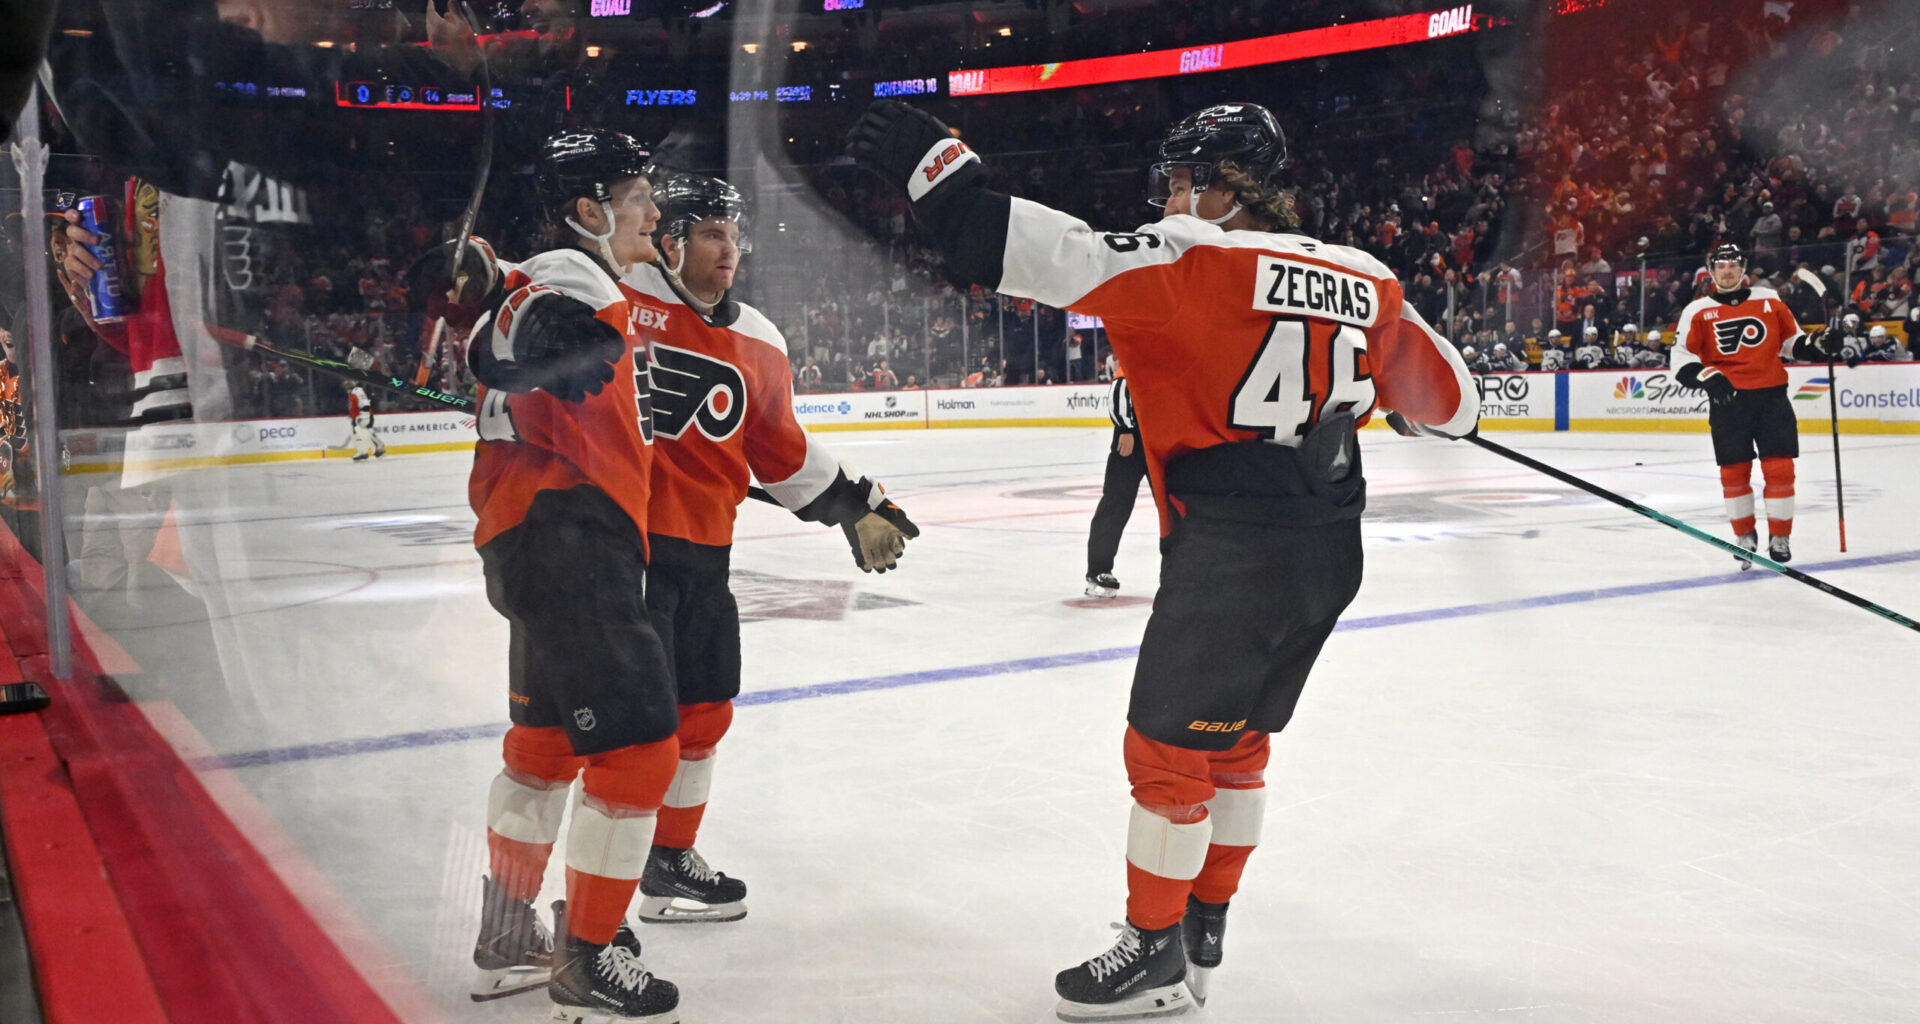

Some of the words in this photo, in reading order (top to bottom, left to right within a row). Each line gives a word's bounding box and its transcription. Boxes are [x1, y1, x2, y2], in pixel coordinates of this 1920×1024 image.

[1428, 4, 1472, 38] GOAL!
[1180, 44, 1223, 73] GOAL!
[873, 79, 924, 98] NOVEMBER
[926, 78, 937, 93] 10
[625, 89, 697, 106] FLYERS
[923, 142, 972, 183] UER
[1266, 263, 1371, 321] ZEGRAS
[1763, 300, 1772, 314] A
[632, 305, 669, 332] IBX
[1227, 315, 1377, 448] 46
[415, 386, 468, 407] AUER
[937, 399, 975, 410] Holman
[1066, 392, 1100, 410] xfinity
[1840, 388, 1920, 409] Constell
[795, 403, 835, 414] ndence
[1479, 404, 1529, 416] RTNER
[259, 426, 296, 442] peco
[373, 425, 389, 433] NK
[392, 425, 406, 433] OF
[409, 423, 457, 432] AMERICA
[1187, 718, 1248, 733] BAUE
[590, 990, 625, 1008] BAUER
